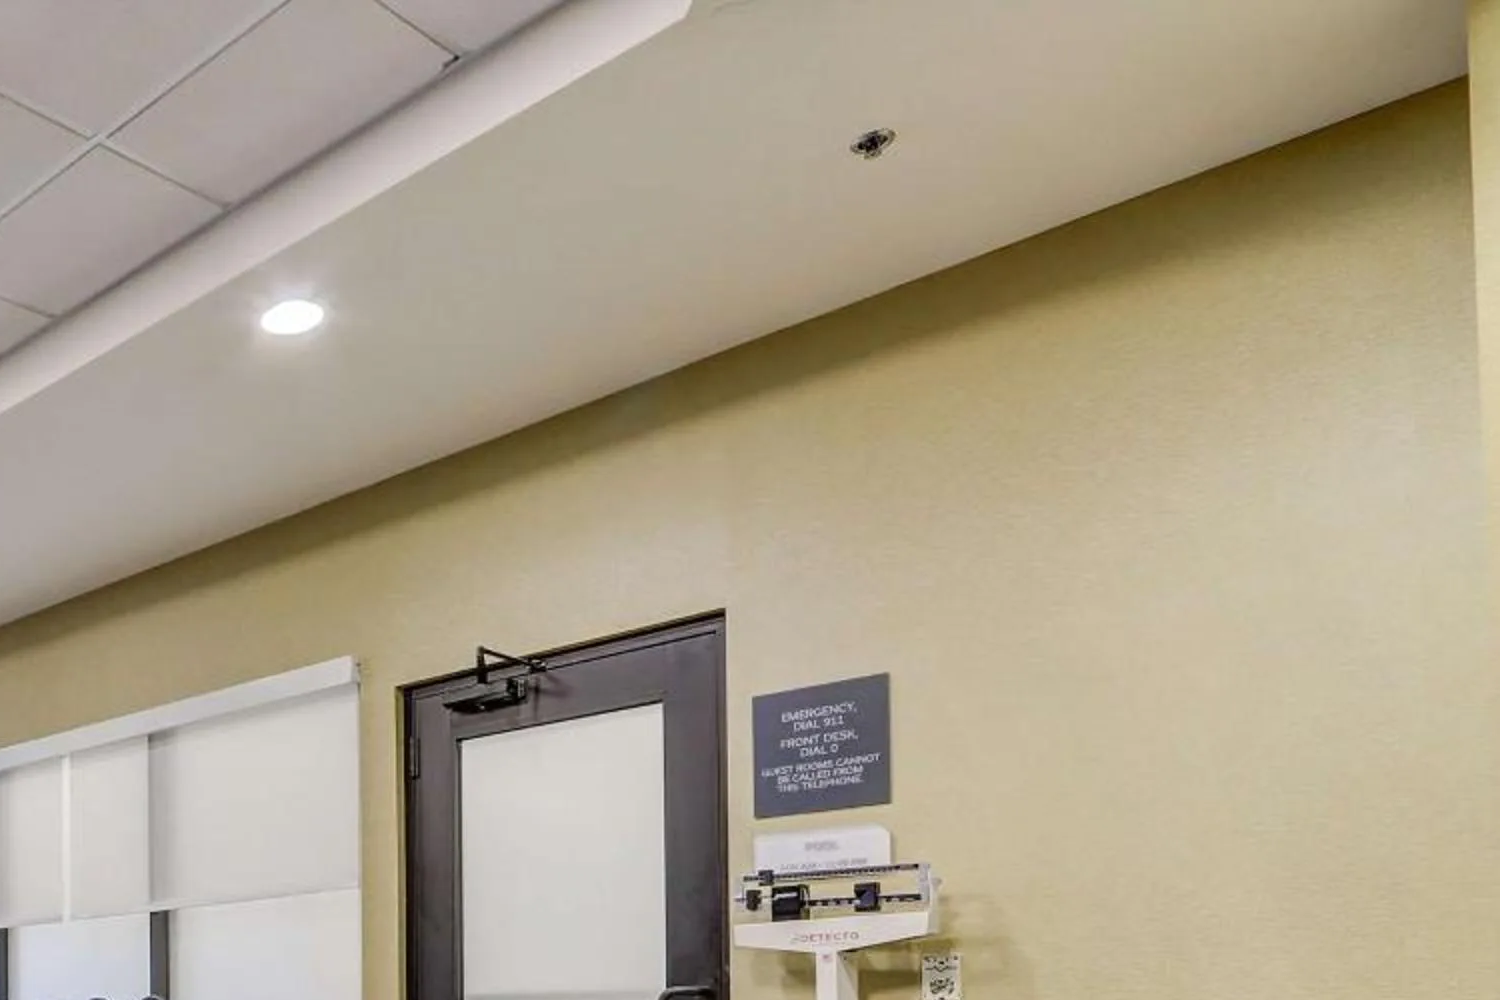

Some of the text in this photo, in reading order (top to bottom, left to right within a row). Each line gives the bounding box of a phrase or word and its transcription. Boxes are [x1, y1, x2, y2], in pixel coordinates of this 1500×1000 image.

[794, 715, 845, 732] DIAL 911
[780, 733, 820, 749] FRONT
[800, 745, 827, 758] DIAL
[836, 753, 881, 767] CANNOT
